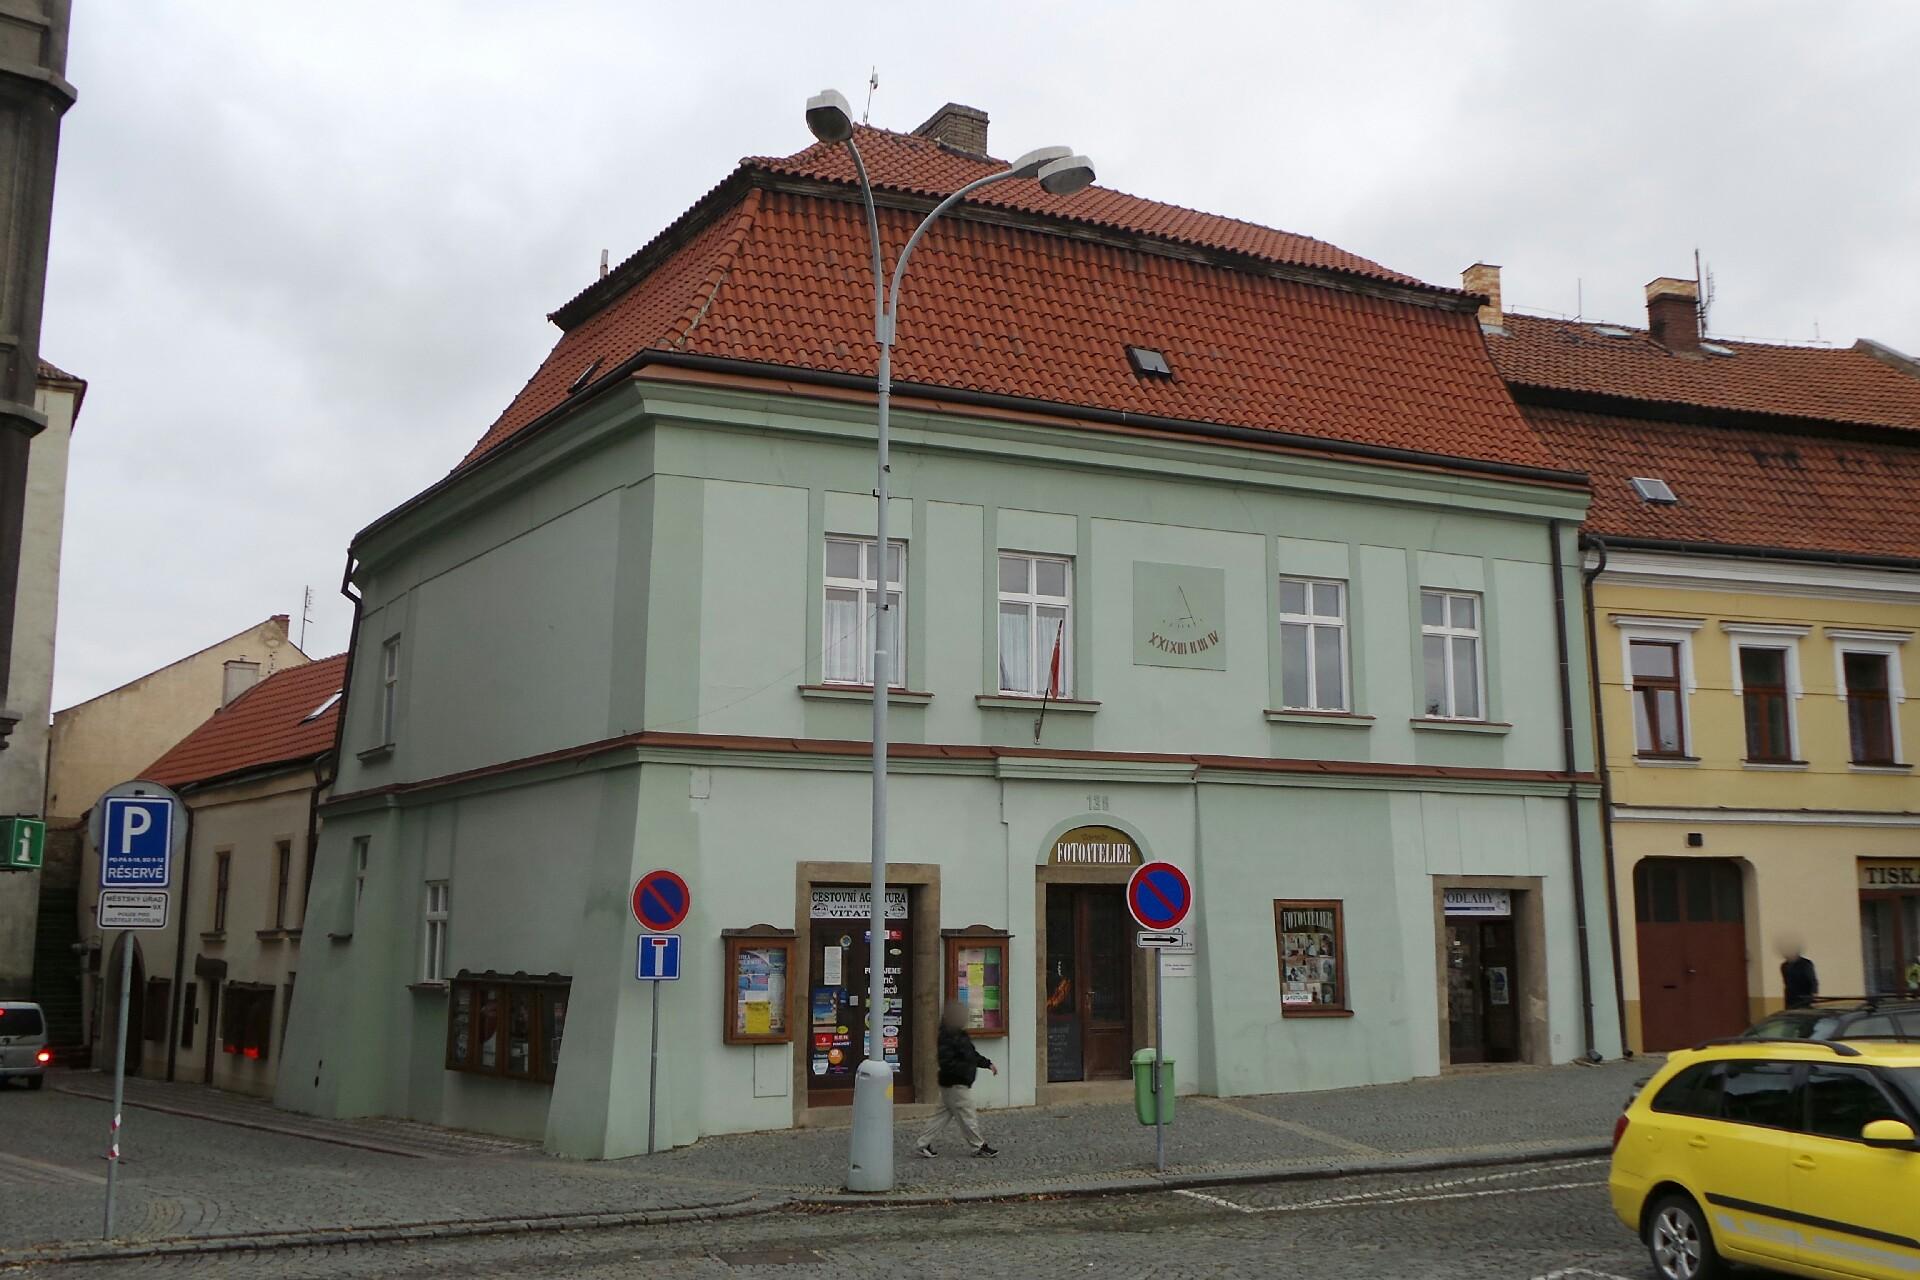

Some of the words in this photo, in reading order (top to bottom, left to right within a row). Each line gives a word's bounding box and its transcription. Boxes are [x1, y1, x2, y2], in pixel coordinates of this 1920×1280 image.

[121, 806, 152, 854] P
[1057, 842, 1131, 864] FOTOATELIER
[108, 864, 164, 879] RÉSERVÉ
[1865, 867, 1920, 884] TISK
[812, 889, 857, 902] CESTOVNÍ
[859, 892, 906, 903] AGTURA
[1443, 891, 1493, 904] ODLAHY
